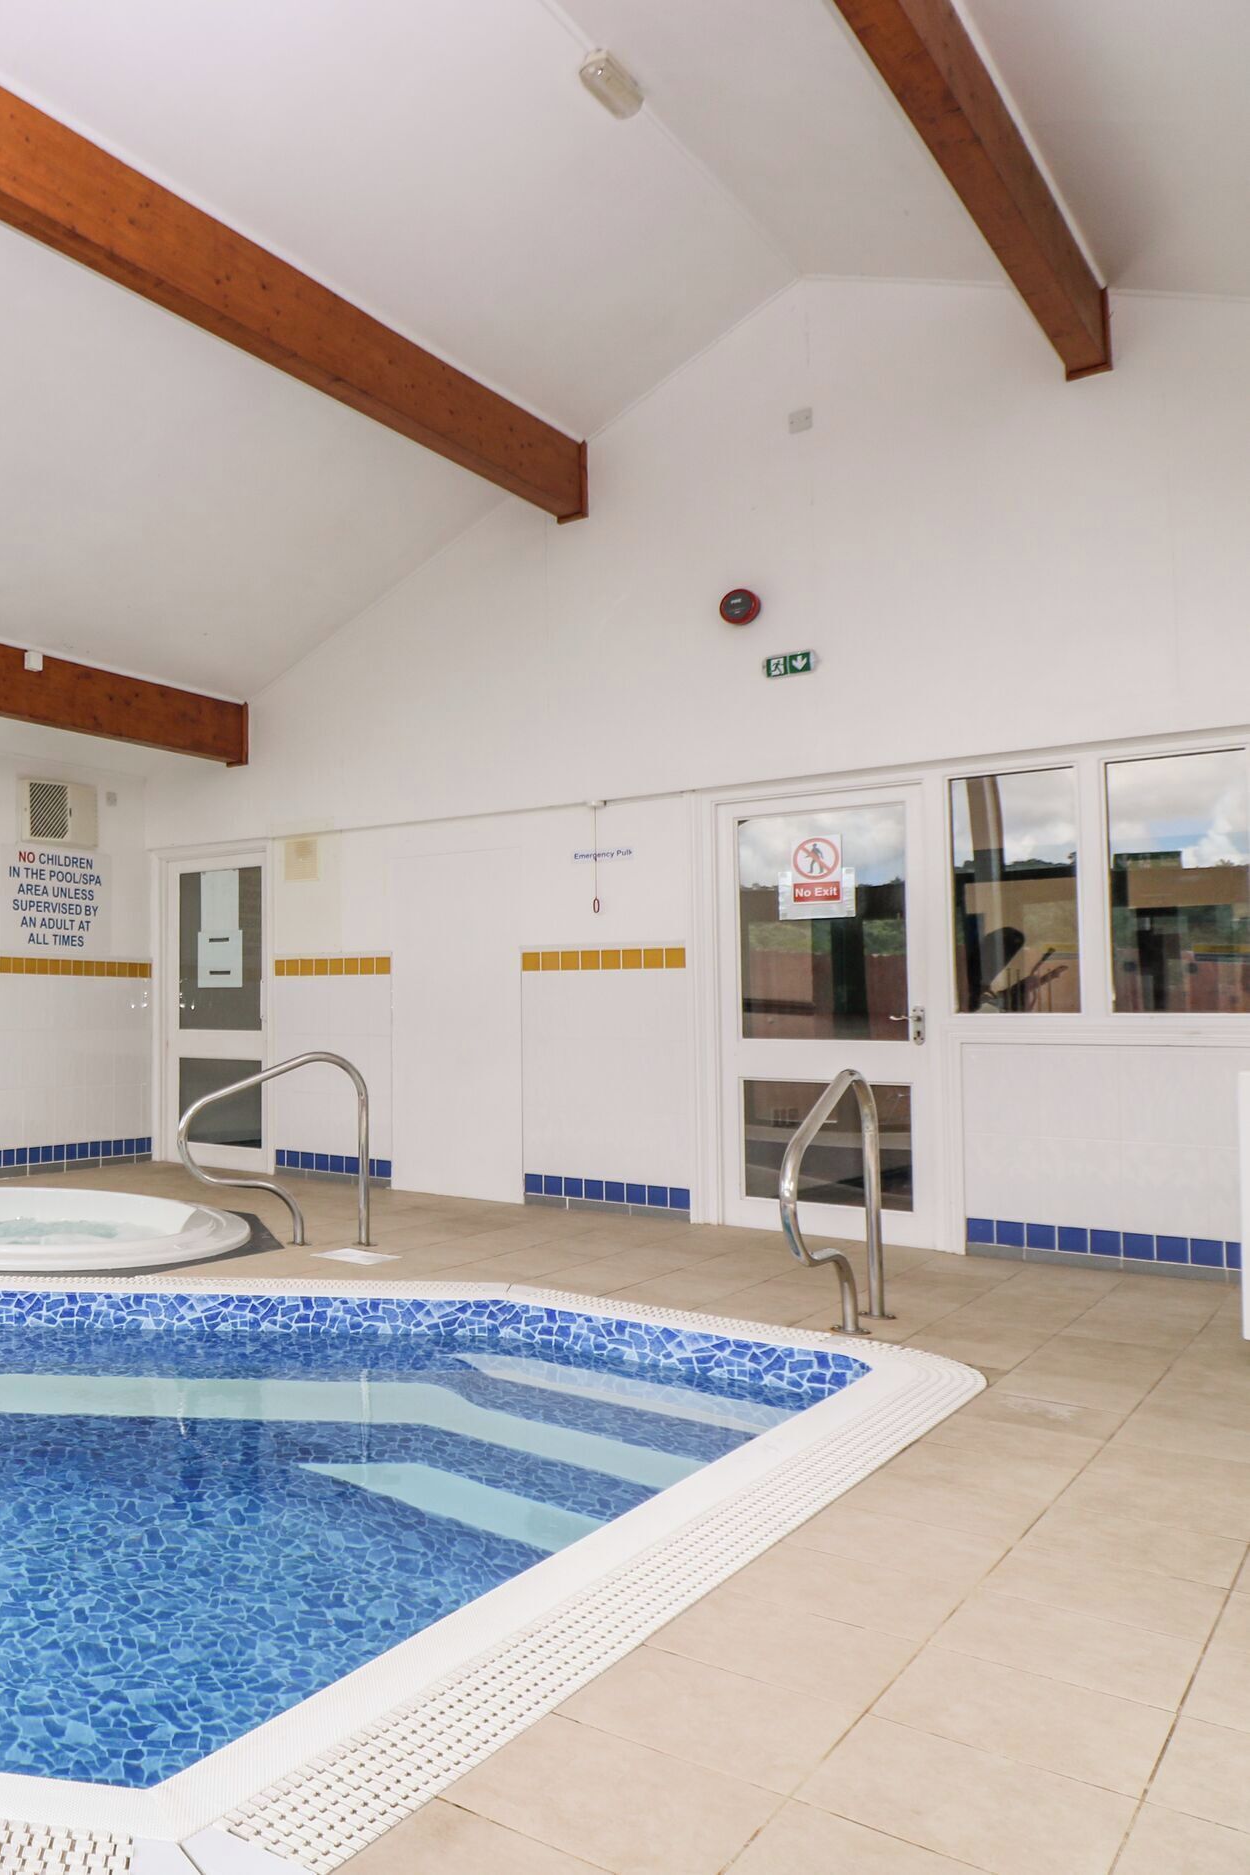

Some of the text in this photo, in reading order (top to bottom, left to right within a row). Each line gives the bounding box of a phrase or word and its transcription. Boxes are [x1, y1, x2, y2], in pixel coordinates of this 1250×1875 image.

[19, 851, 93, 870] NO CHILDREN
[574, 851, 614, 861] Emergency
[9, 866, 102, 886] IN THE POOL/SPA
[18, 884, 94, 901] AREA UNLESS
[795, 887, 837, 897] No Exit
[12, 899, 98, 917] SUPERVISED BY
[21, 916, 91, 931] AN ADULT AT
[28, 933, 84, 947] ALL TIMES
